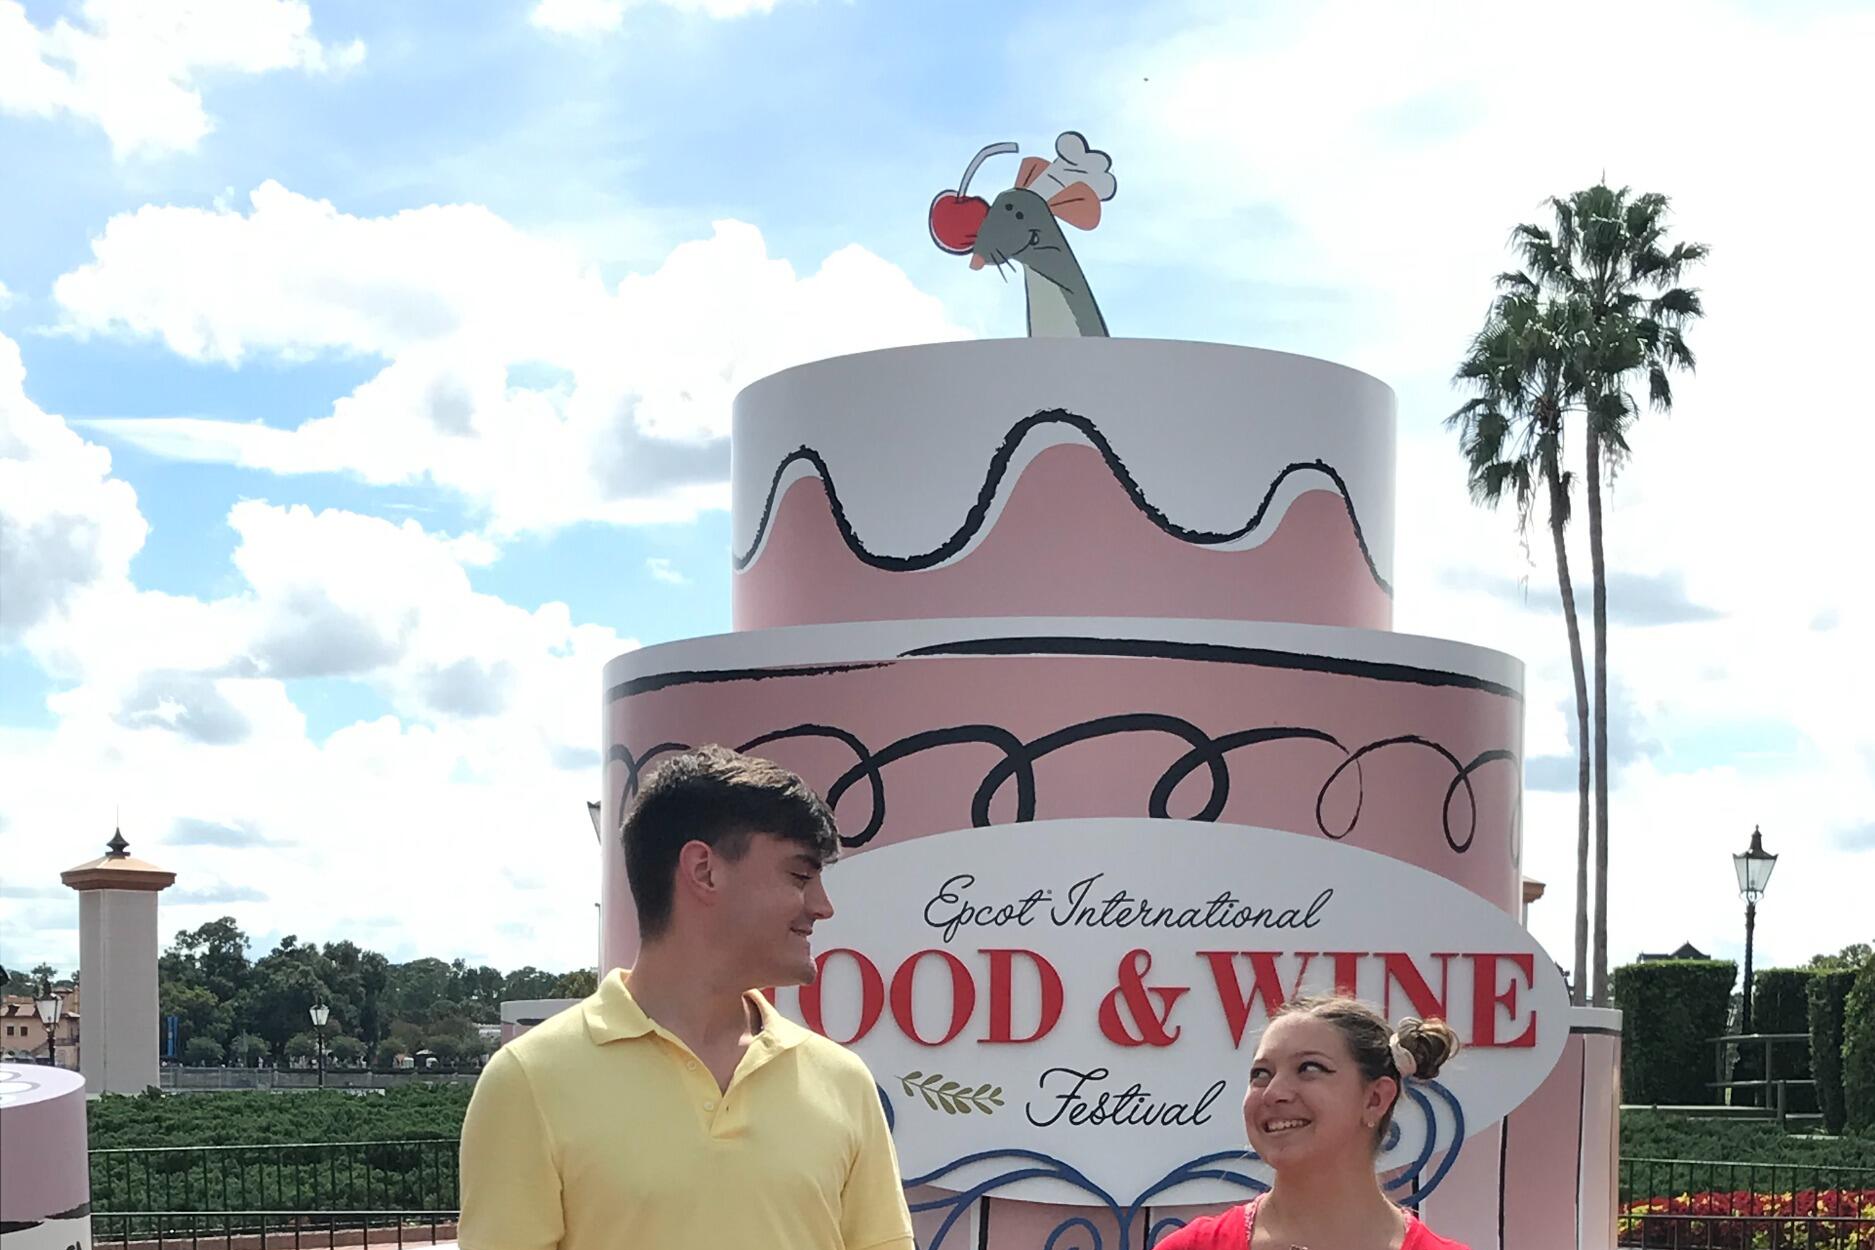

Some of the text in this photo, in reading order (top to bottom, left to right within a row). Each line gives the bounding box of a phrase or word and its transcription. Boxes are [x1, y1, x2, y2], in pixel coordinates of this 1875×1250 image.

[923, 871, 1335, 944] Epcot International
[764, 948, 1064, 1046] OOD
[1098, 948, 1190, 1047] &
[1025, 1066, 1227, 1128] Festival
